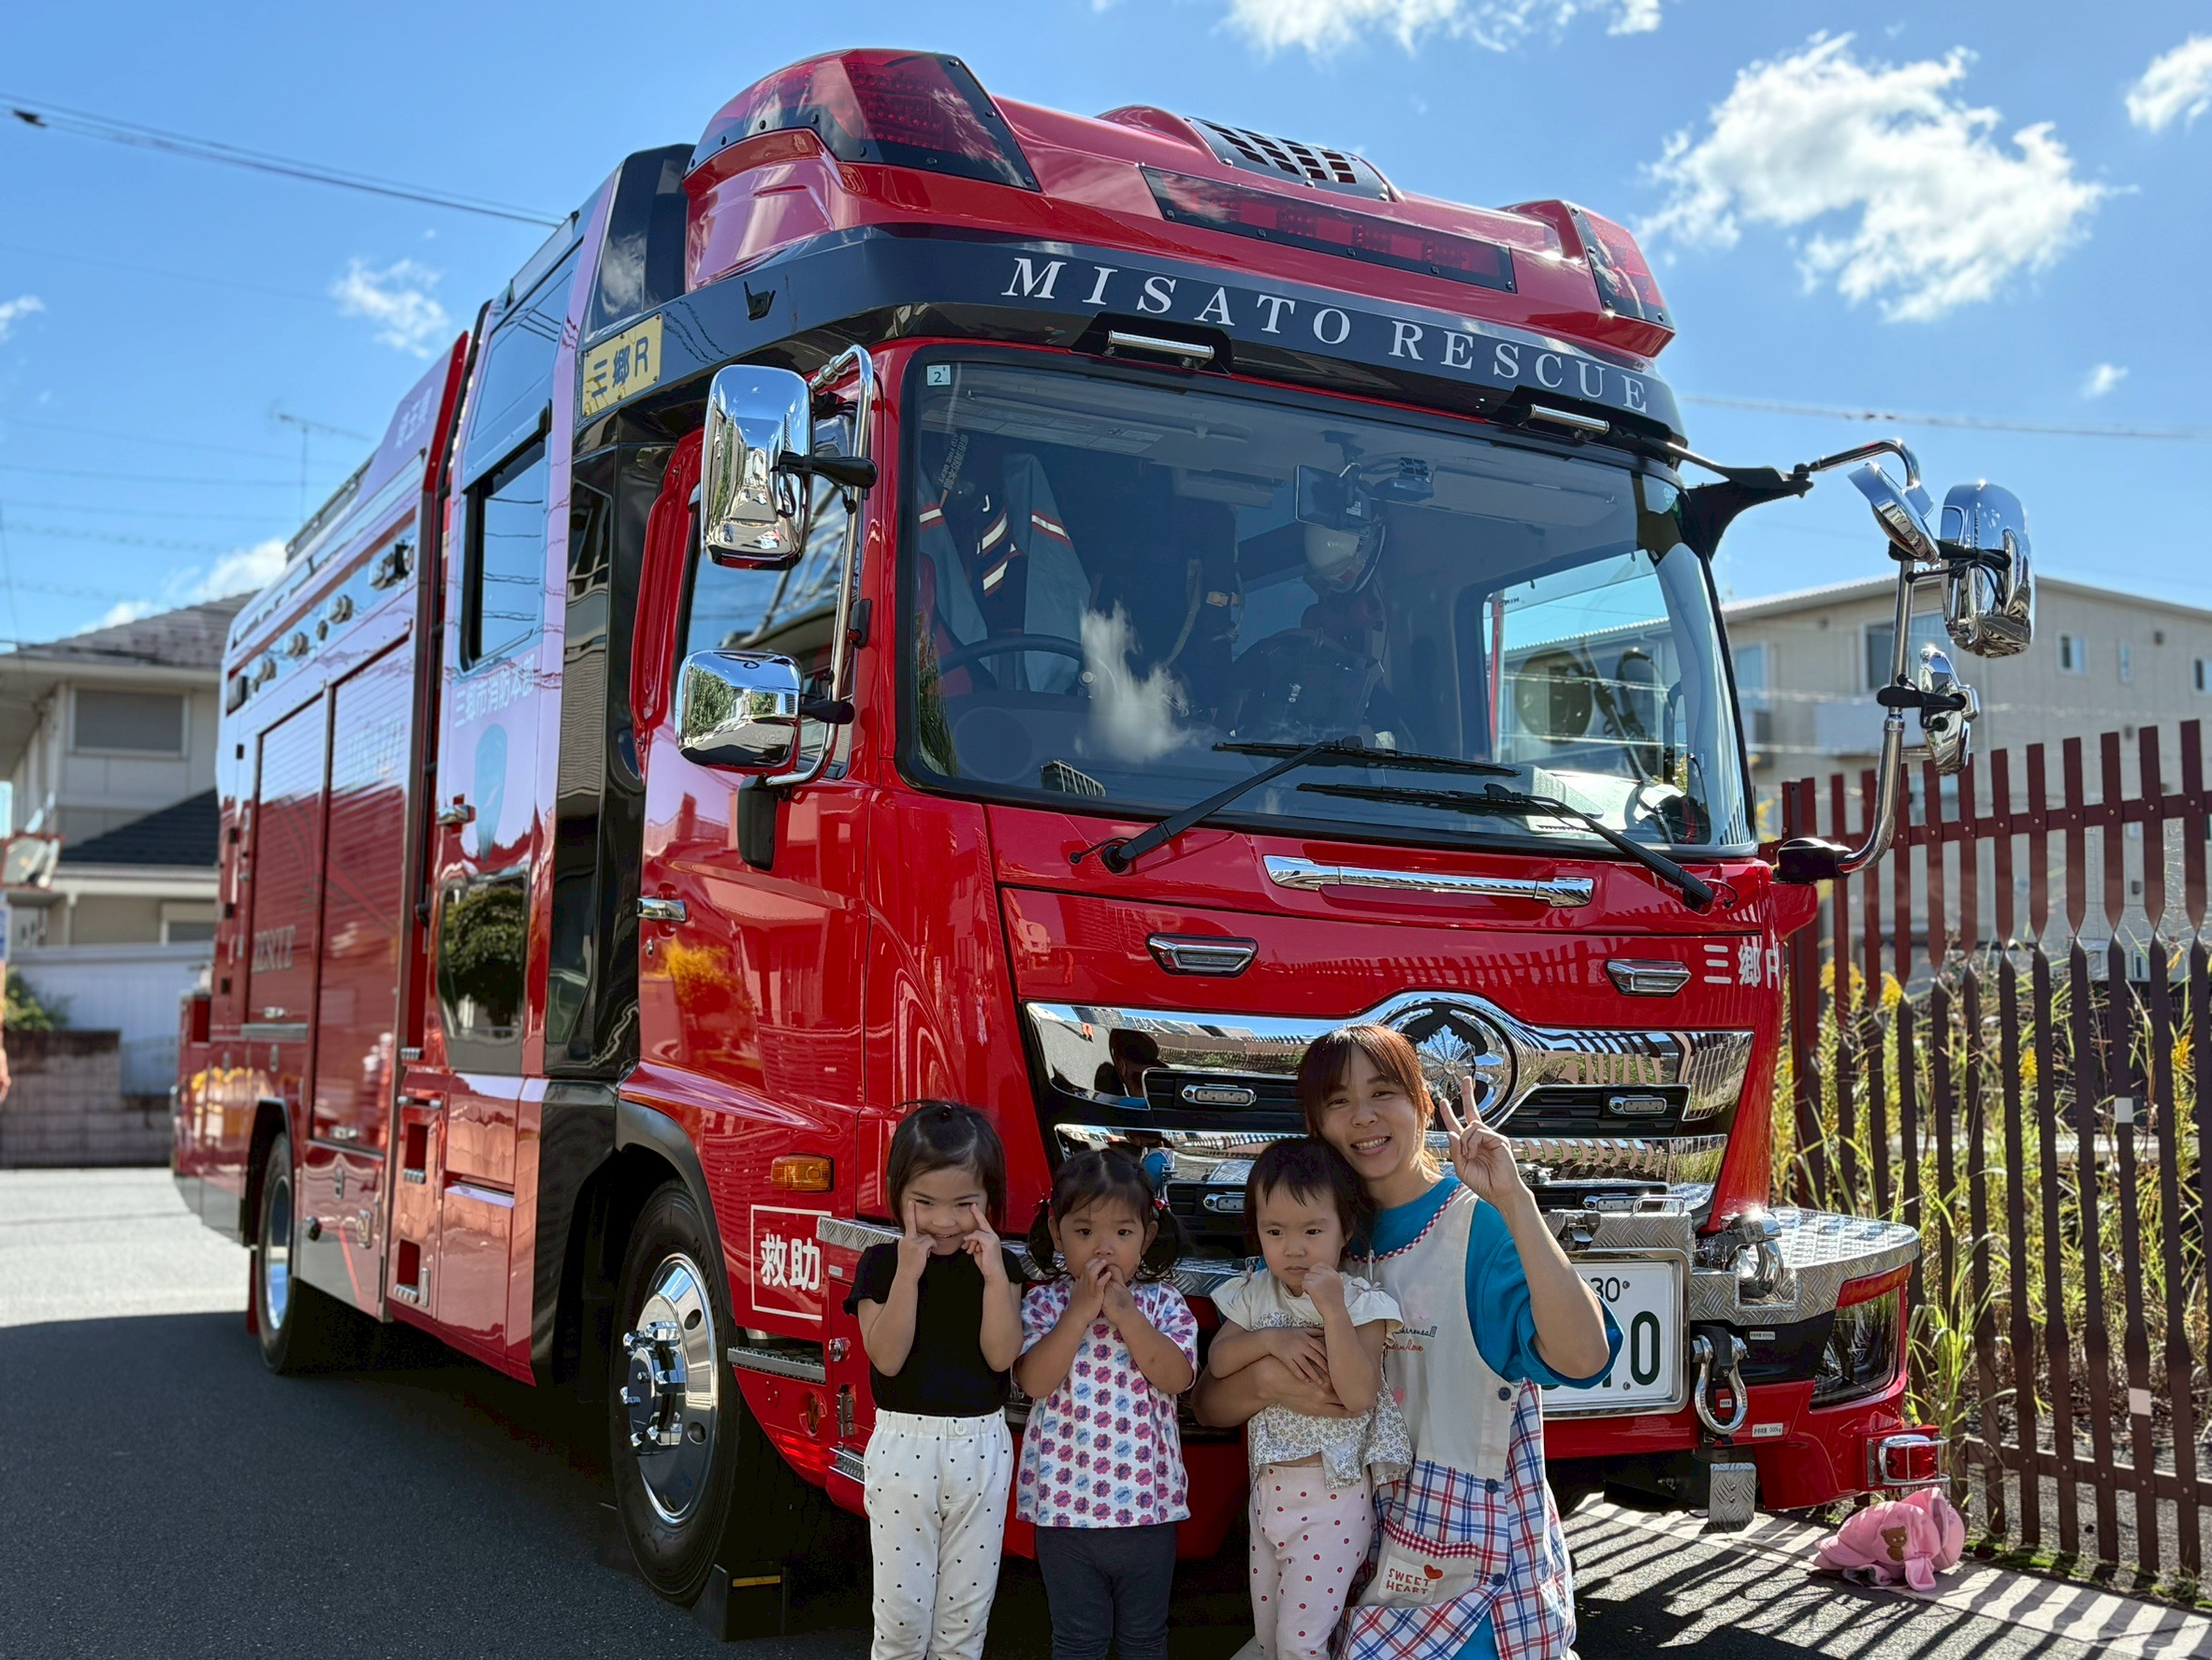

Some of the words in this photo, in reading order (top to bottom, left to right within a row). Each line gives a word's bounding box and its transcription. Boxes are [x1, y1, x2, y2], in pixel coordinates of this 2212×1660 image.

[1001, 257, 1350, 344] MISATO
[1389, 320, 1648, 414] RESCUE
[591, 336, 648, 398] 三郷R
[934, 371, 943, 383] 2
[761, 1232, 821, 1291] 救助
[1583, 1276, 1621, 1303] 30
[1386, 1580, 1430, 1594] HEART
[1389, 1567, 1431, 1587] SWEET
